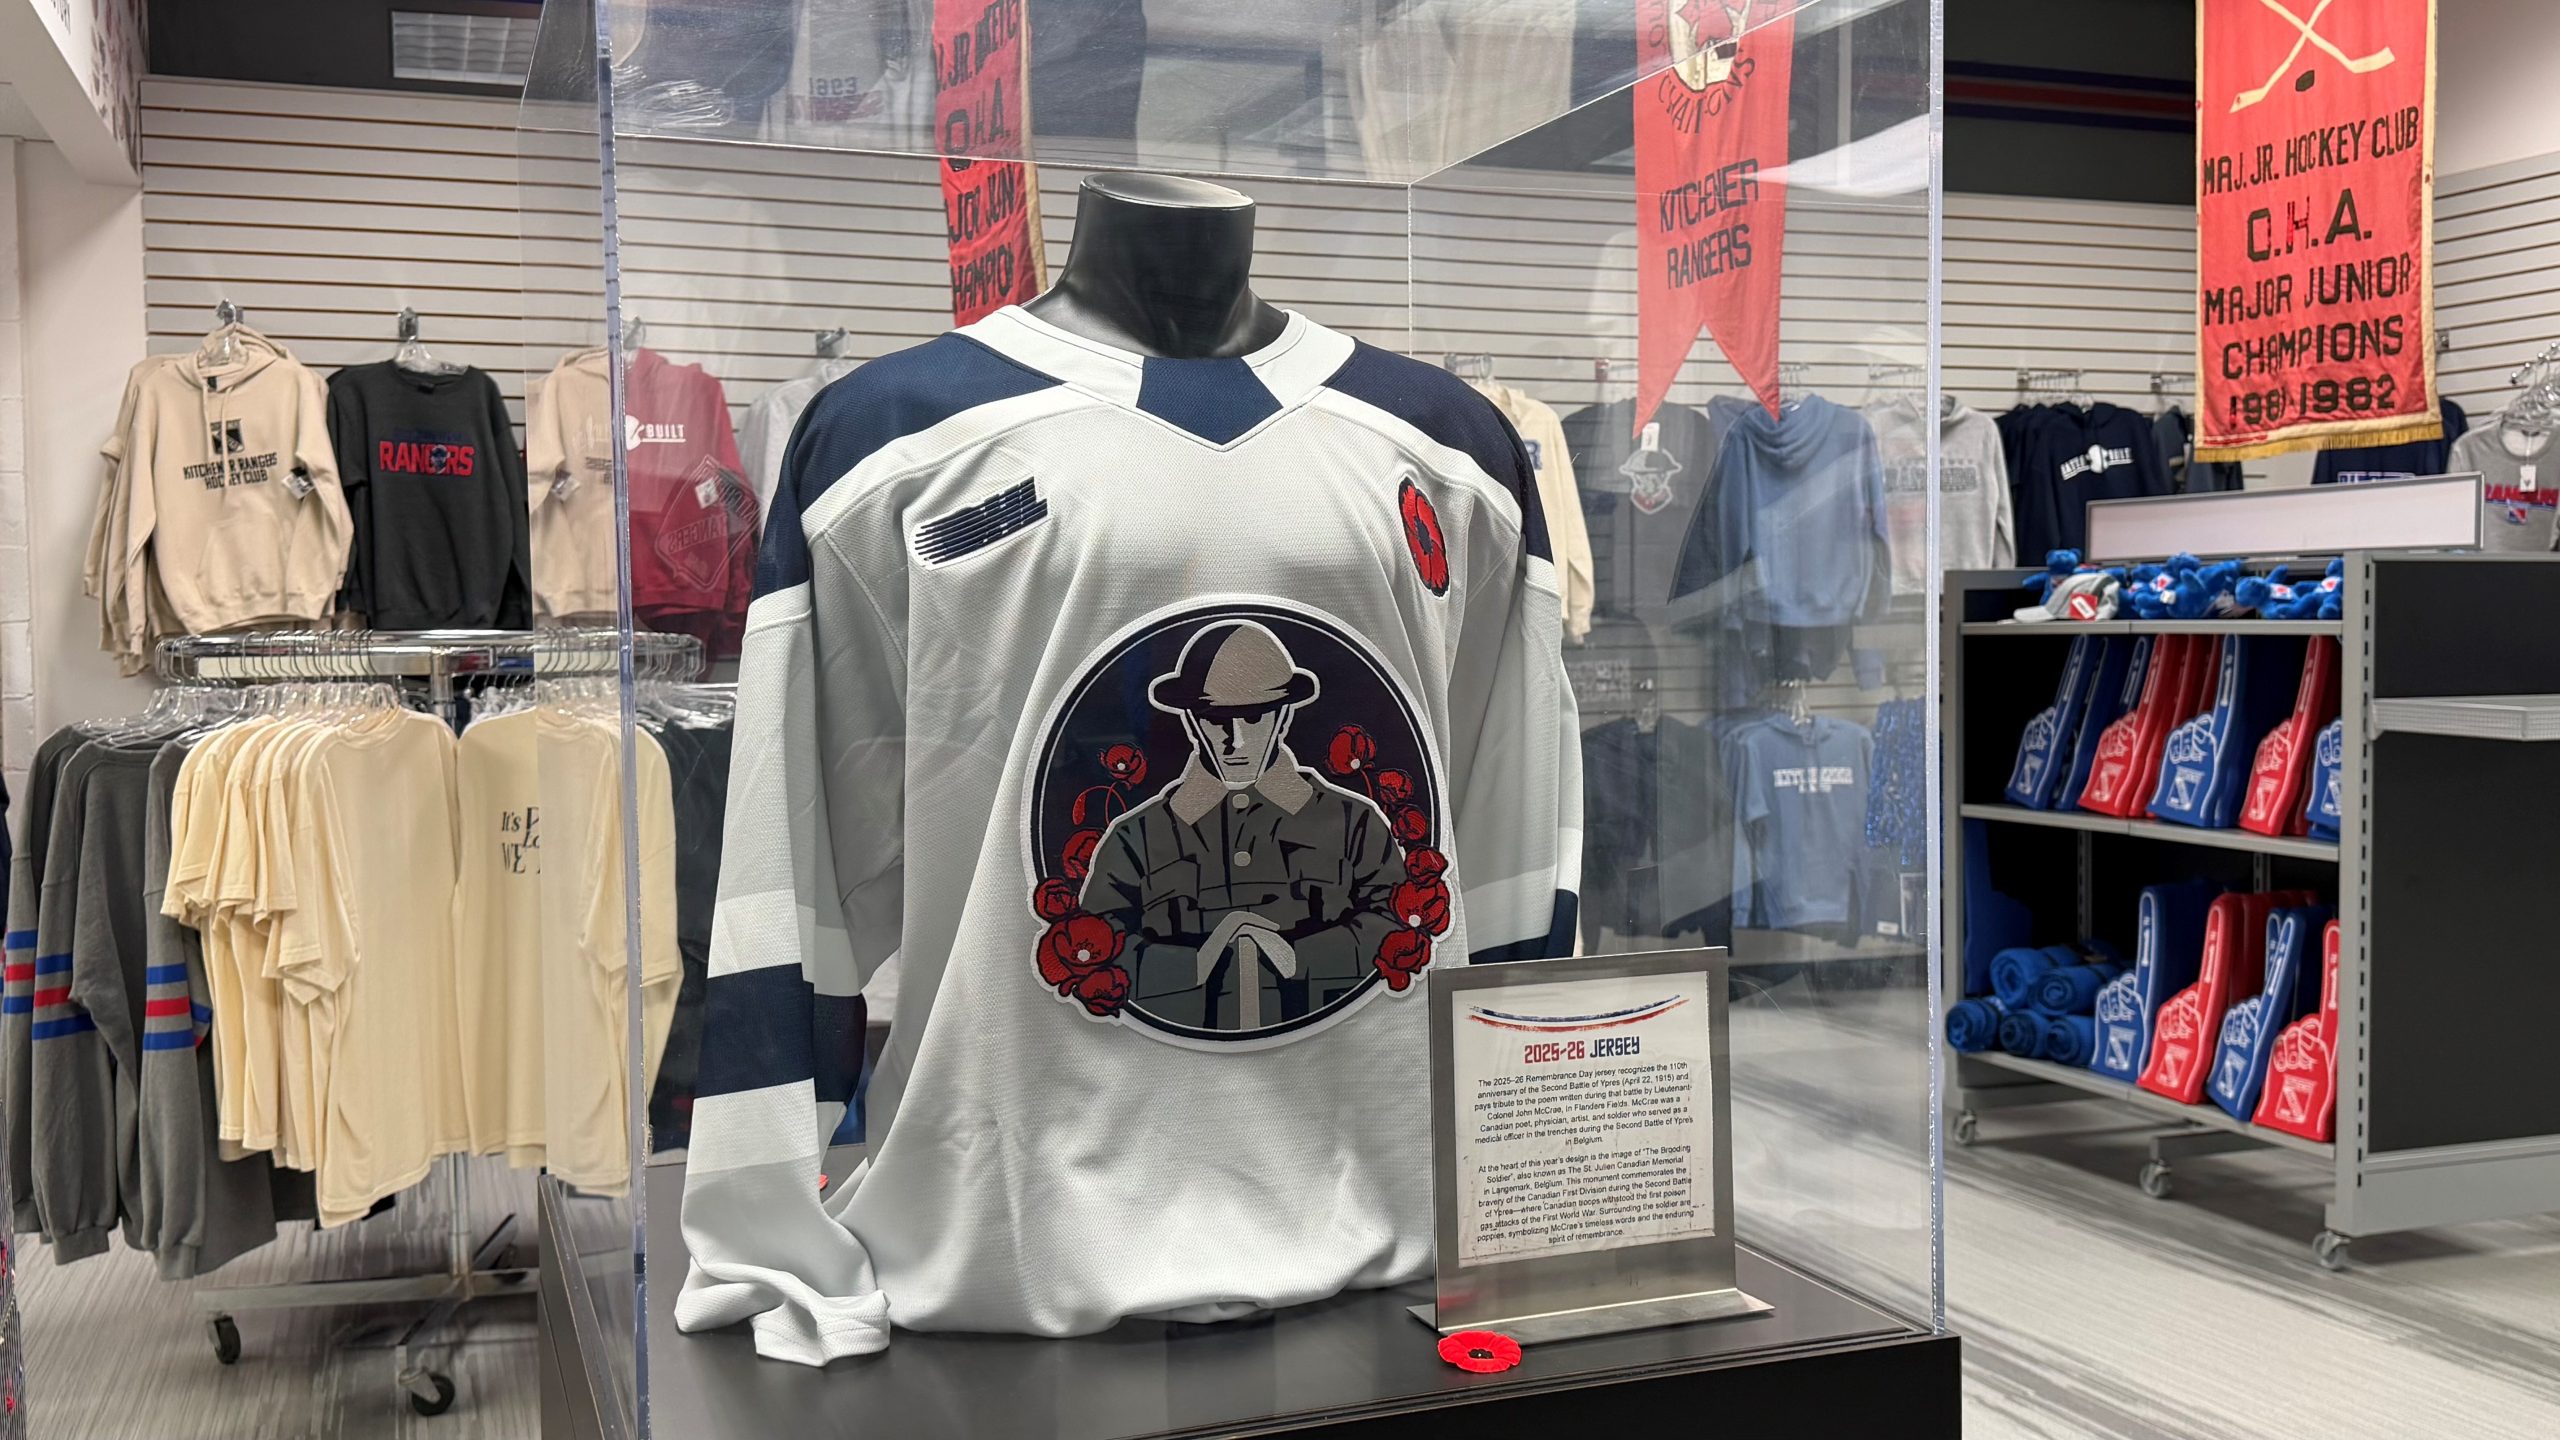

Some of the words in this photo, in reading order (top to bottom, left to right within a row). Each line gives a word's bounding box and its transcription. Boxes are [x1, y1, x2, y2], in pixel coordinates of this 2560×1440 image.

[2203, 153, 2246, 196] MAJ.
[2250, 143, 2280, 186] JR.
[2285, 120, 2366, 178] HOCKEY
[2371, 106, 2419, 159] CLUB
[1660, 158, 1758, 233] KITCHENER
[2247, 188, 2372, 262] O.H.A.
[1667, 223, 1752, 290] RANGERS
[2204, 273, 2293, 326] MAJOR
[2304, 252, 2411, 309] JUNIOR
[2222, 314, 2403, 380] CHAMPIONS
[646, 423, 685, 438] BUILT
[183, 458, 237, 480] KITCHENR
[240, 452, 278, 471] RANGERS
[379, 440, 475, 477] RANGRS
[205, 473, 242, 490] HOCEY
[244, 469, 268, 484] CLUB
[501, 811, 522, 832] It's
[1525, 1041, 1584, 1063] 2025-26
[1590, 1036, 1639, 1058] JERSEY
[1526, 1073, 1577, 1082] Remembrance
[1579, 1071, 1592, 1079] Day
[1595, 1069, 1615, 1077] jersey
[1618, 1066, 1655, 1074] recognizes
[1670, 1062, 1687, 1070] 110th
[1478, 1089, 1518, 1099] anniversary
[1541, 1084, 1567, 1092] Second
[1601, 1079, 1620, 1087] Ypres
[1622, 1077, 1640, 1086] (April
[1655, 1074, 1674, 1082] 1915)
[1538, 1095, 1557, 1105] poem
[1559, 1094, 1582, 1102] written
[1585, 1091, 1606, 1100] during
[1645, 1087, 1652, 1095] by
[1655, 1084, 1692, 1093] Lieutenant-
[1480, 1123, 1513, 1132] Canadian
[1515, 1120, 1532, 1129] poet,
[1534, 1117, 1569, 1127] physician,
[1608, 1110, 1630, 1118] soldier
[1632, 1108, 1647, 1116] who
[1649, 1106, 1671, 1115] served
[1487, 1111, 1513, 1120] Colonel
[1535, 1107, 1563, 1115] McCrae,
[1575, 1102, 1605, 1111] Flanders
[1632, 1097, 1658, 1106] McCrae
[1475, 1133, 1501, 1144] medical
[1504, 1131, 1524, 1140] officer
[1535, 1129, 1545, 1137] the
[1548, 1127, 1577, 1135] trenches
[1579, 1124, 1601, 1133] during
[1616, 1121, 1642, 1129] Second
[1645, 1118, 1663, 1127] Battle
[1500, 1162, 1518, 1170] heart
[1529, 1159, 1541, 1167] this
[1543, 1157, 1563, 1166] year's
[1566, 1155, 1588, 1163] design
[1611, 1150, 1632, 1159] image
[1661, 1145, 1691, 1153] Brooding
[1517, 1171, 1531, 1180] also
[1534, 1168, 1556, 1177] known
[1568, 1166, 1581, 1174] The
[1595, 1163, 1615, 1171] Julien
[1617, 1159, 1650, 1168] Canadian
[1652, 1156, 1684, 1165] Memorial
[1479, 1197, 1504, 1207] bravery
[1515, 1194, 1525, 1202] the
[1528, 1191, 1560, 1201] Canadian
[1580, 1186, 1607, 1194] Division
[1609, 1184, 1630, 1192] during
[1645, 1180, 1670, 1188] Second
[1492, 1184, 1532, 1194] Langemark,
[1583, 1174, 1619, 1183] monument
[1622, 1169, 1674, 1179] commemorates
[1480, 1223, 1492, 1231] gas
[1495, 1219, 1519, 1227] attacks
[1543, 1213, 1558, 1221] First
[1560, 1211, 1579, 1219] World
[1600, 1204, 1641, 1215] Surrounding
[1656, 1200, 1678, 1209] soldier
[1485, 1210, 1492, 1218] of
[1544, 1200, 1576, 1209] Canadian
[1579, 1198, 1600, 1206] troops
[1602, 1193, 1634, 1203] withstood
[1649, 1190, 1662, 1198] first
[1664, 1189, 1686, 1198] poison
[1477, 1232, 1506, 1242] poppies,
[1509, 1227, 1548, 1238] symbolizing
[1551, 1221, 1583, 1232] McCrae's
[1585, 1219, 1613, 1228] timeless
[1616, 1216, 1635, 1224] words
[1665, 1210, 1694, 1219] enduring
[1549, 1234, 1565, 1244] spirit
[1576, 1228, 1624, 1240] remembrance.
